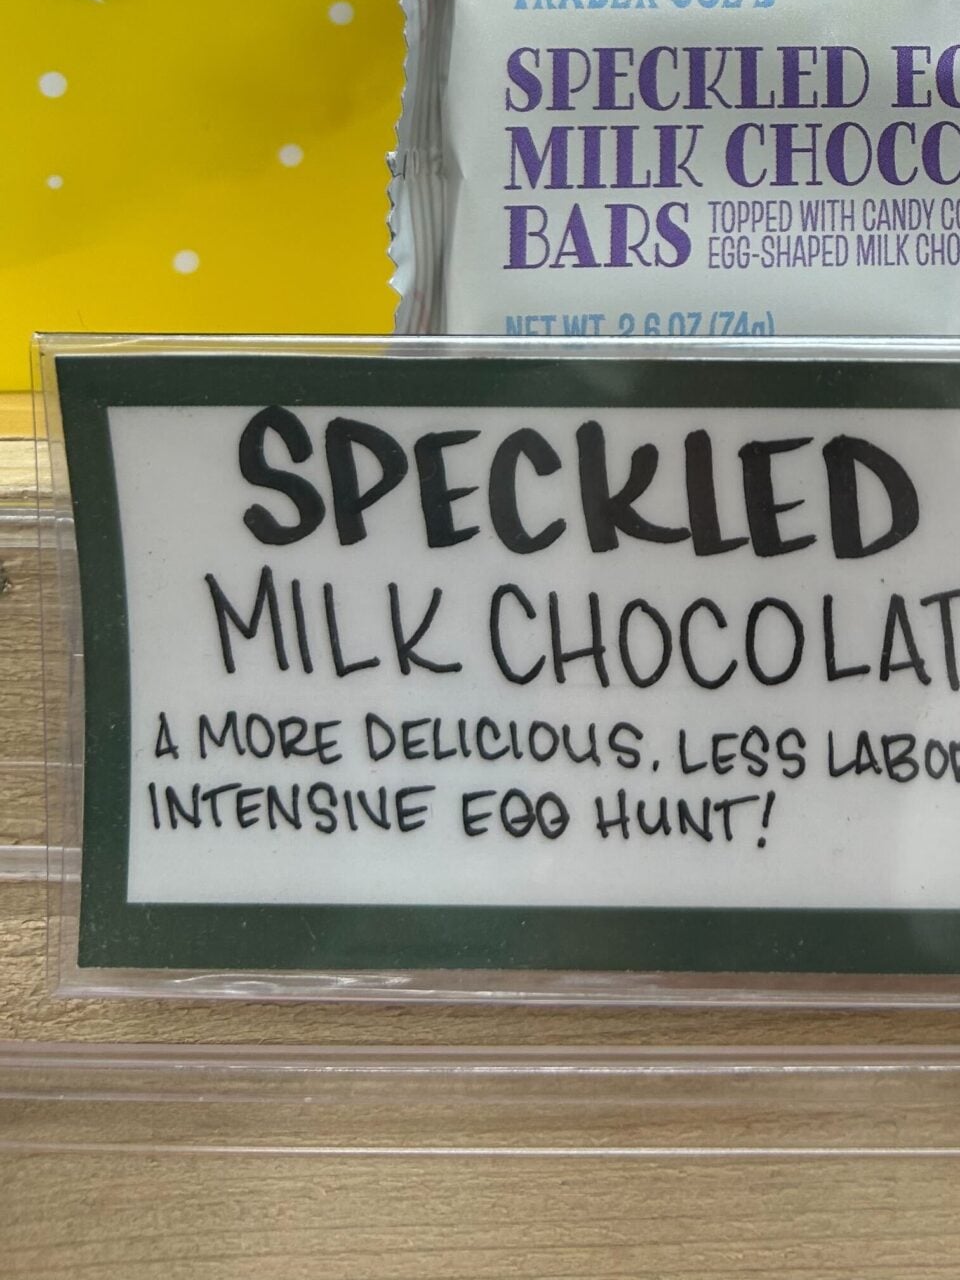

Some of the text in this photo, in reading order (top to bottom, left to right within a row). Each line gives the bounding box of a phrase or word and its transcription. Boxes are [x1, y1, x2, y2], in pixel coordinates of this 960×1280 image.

[505, 46, 871, 113] SPECKLED
[503, 124, 705, 190] MILK
[503, 202, 691, 270] BARS
[708, 200, 793, 233] TOPPED
[799, 199, 856, 232] WITH
[862, 198, 936, 231] CANDY
[707, 234, 849, 269] EGG-SHAPED
[856, 233, 910, 266] MILK
[238, 405, 921, 560] SPECKLED
[204, 566, 462, 675] MILK
[154, 712, 180, 761] A
[199, 712, 343, 764] MORE
[680, 725, 806, 776] LESS
[148, 782, 778, 850] INTENSIVE EGG HUNT!
